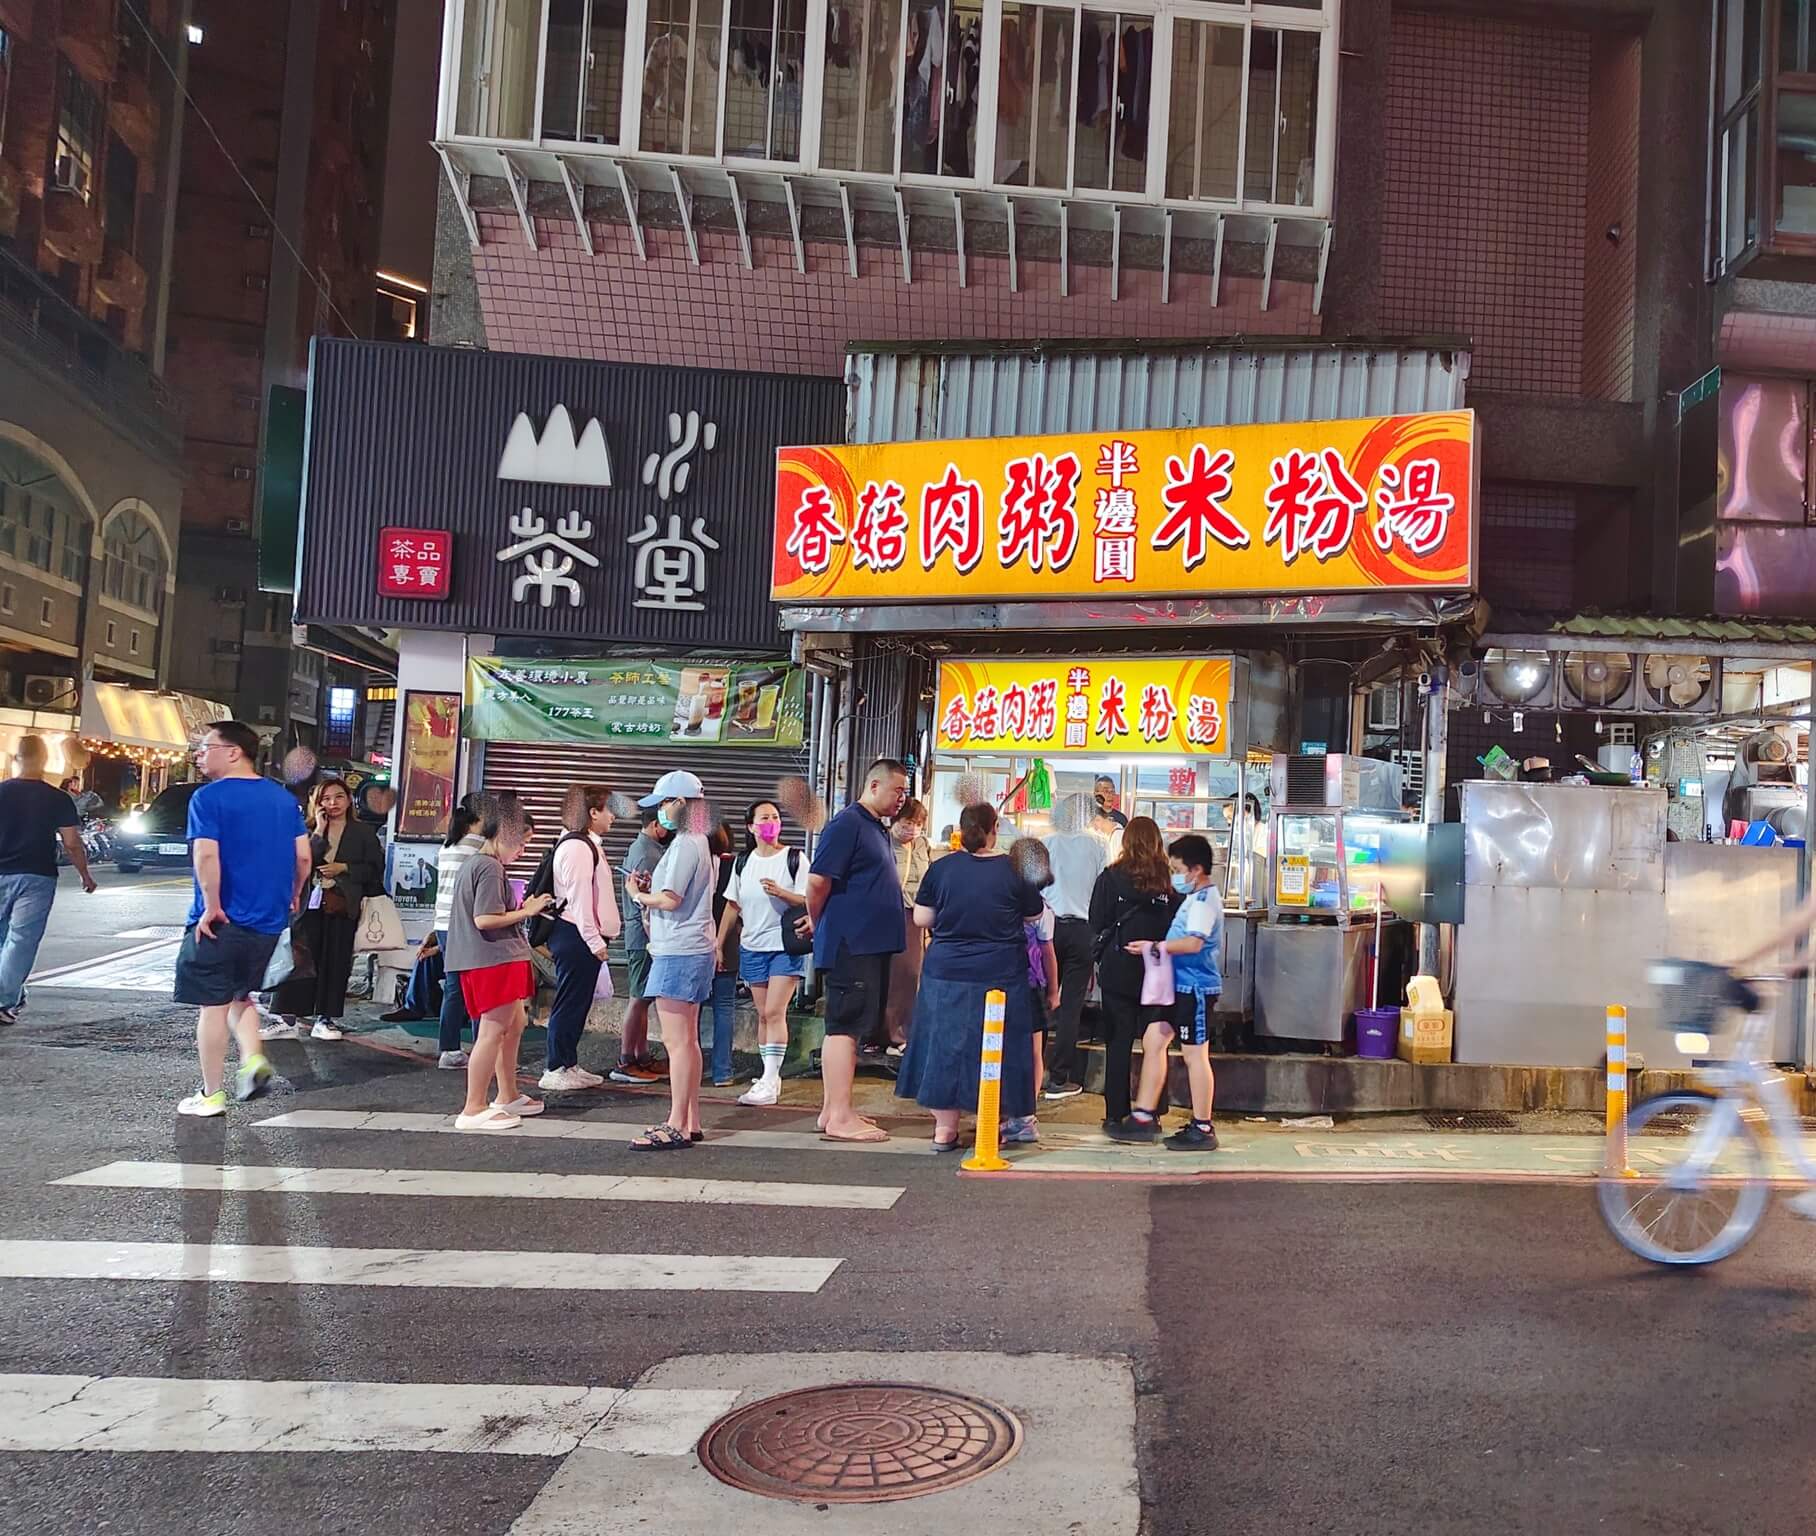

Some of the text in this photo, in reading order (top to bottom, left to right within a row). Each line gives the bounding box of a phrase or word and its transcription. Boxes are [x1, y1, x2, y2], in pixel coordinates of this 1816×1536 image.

[390, 539, 441, 560] 茶品
[787, 453, 1082, 575] 香菇肉粥
[1094, 440, 1139, 583] 半邊圓
[1151, 443, 1455, 571] 米粉湯
[496, 506, 720, 611] 茶堂
[943, 678, 1058, 742] 香菇肉粥
[1064, 667, 1090, 748] 半邊圓
[1096, 674, 1222, 744] 米粉湯
